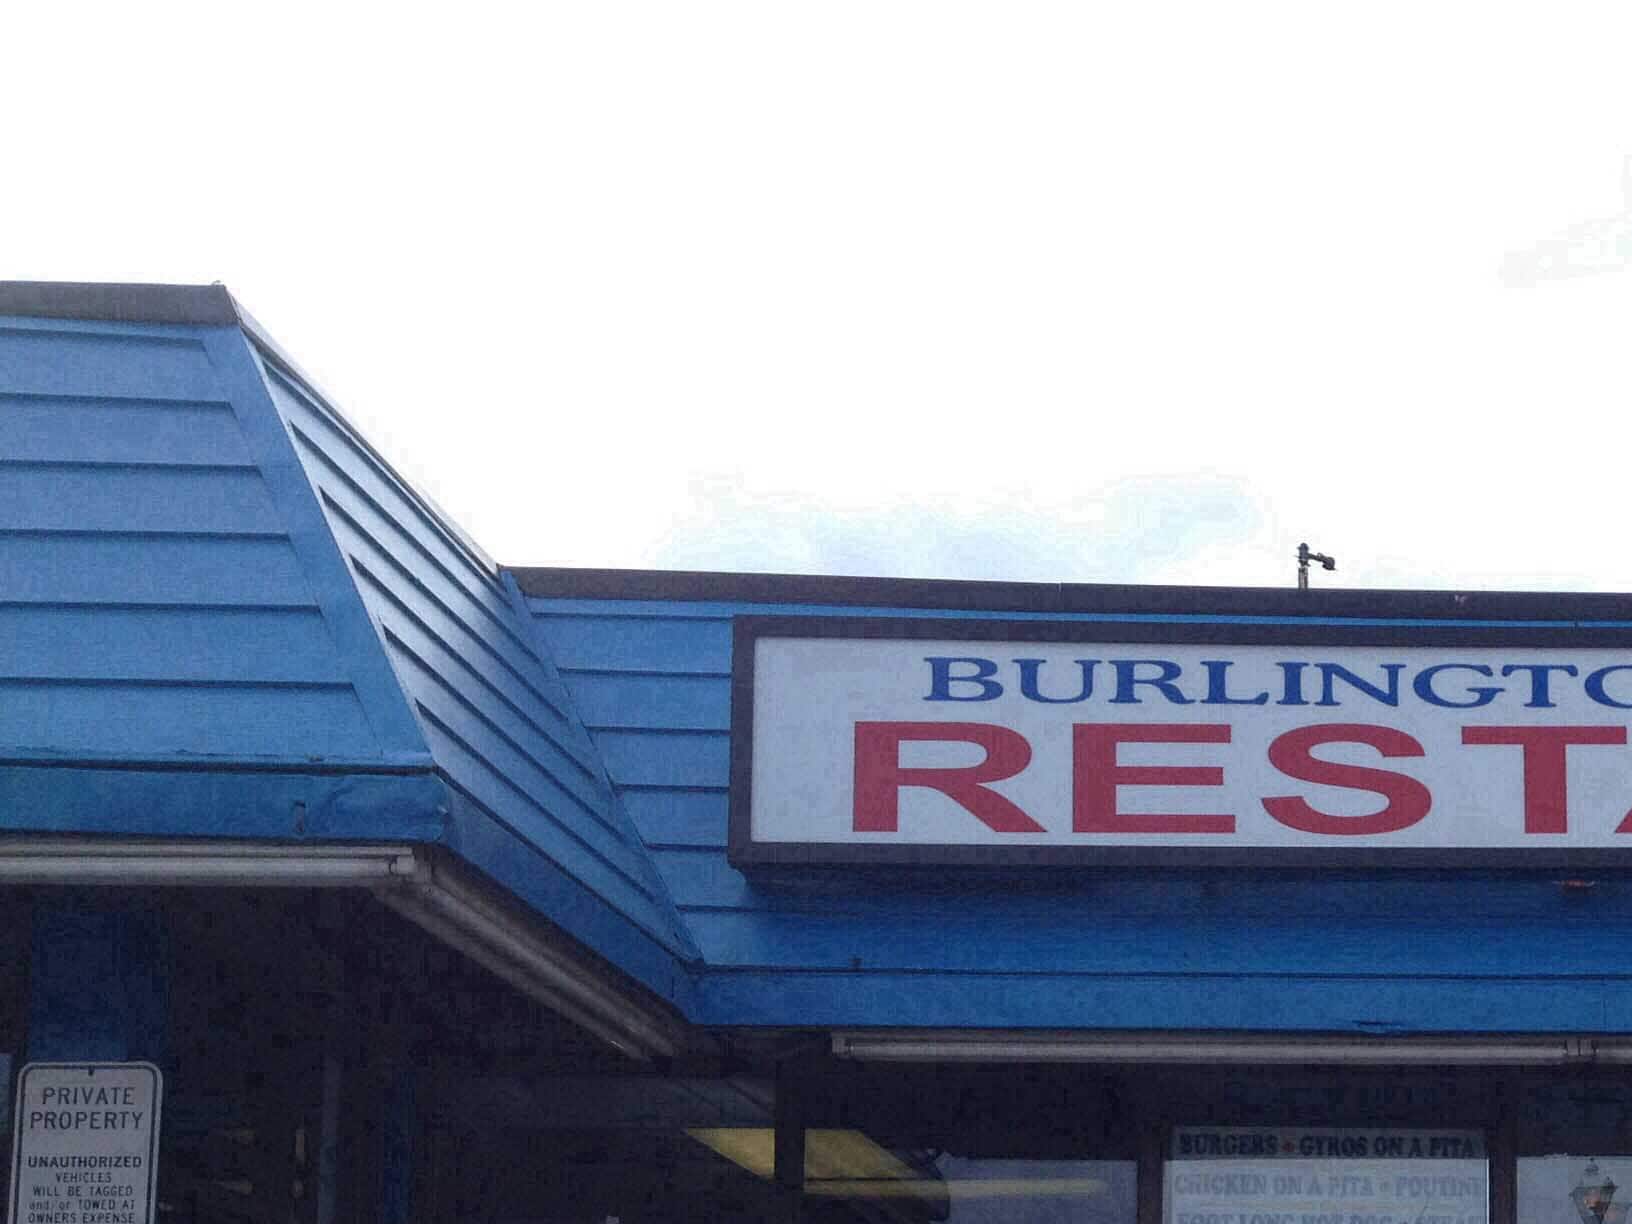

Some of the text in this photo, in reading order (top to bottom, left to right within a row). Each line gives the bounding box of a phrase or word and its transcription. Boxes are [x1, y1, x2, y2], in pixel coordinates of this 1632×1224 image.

[42, 1086, 136, 1105] PRIVATE
[30, 1111, 144, 1130] PROPERTY
[1179, 1134, 1278, 1155] BURGERS
[1300, 1136, 1369, 1157] GYROS
[1373, 1137, 1402, 1158] ON
[1407, 1137, 1424, 1158] A
[28, 1155, 142, 1169] UNAUTHORIZED
[55, 1171, 113, 1184] VEHICLES
[33, 1185, 134, 1197] WILL BE TAGGED
[1175, 1174, 1267, 1196] CHICKEN
[1273, 1174, 1303, 1196] ON
[1307, 1174, 1324, 1196] A
[1328, 1175, 1376, 1197] PITA
[78, 1199, 116, 1211] TOWED
[122, 1199, 136, 1210] AT
[28, 1212, 136, 1224] OWNERS EXPENSE
